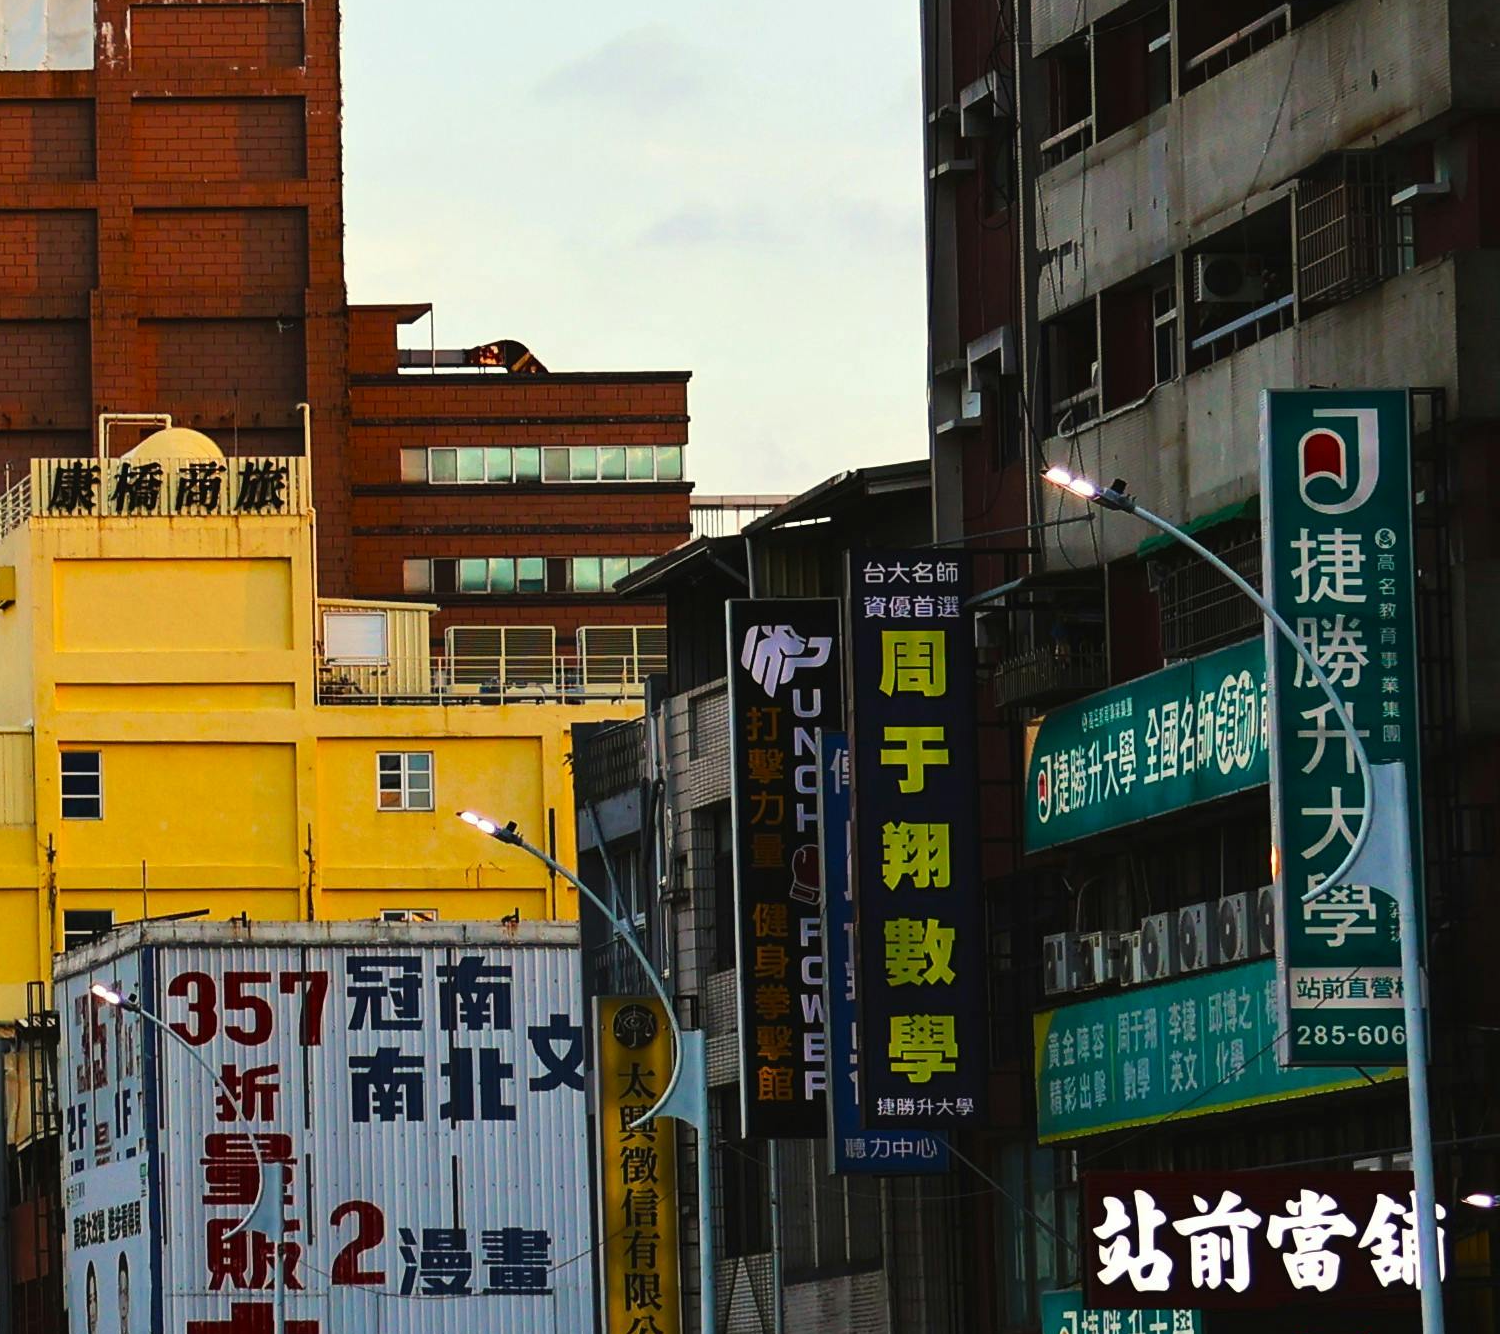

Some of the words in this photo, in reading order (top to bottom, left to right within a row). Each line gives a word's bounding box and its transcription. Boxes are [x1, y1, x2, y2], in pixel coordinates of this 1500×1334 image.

[50, 459, 290, 513] 康橋商旅
[862, 560, 960, 587] 台大名師
[863, 594, 962, 619] 資優首選
[1143, 690, 1216, 786] 全國名師
[1290, 526, 1377, 948] 捷勝升大學
[746, 705, 788, 870] 打擊力量
[1053, 728, 1137, 817] 捷勝升大學
[879, 628, 961, 1086] 周于翔數學
[167, 970, 329, 1048] 357
[347, 955, 513, 1032] 冠南
[753, 902, 794, 1103] 健身拳擊館
[1208, 987, 1252, 1035] 邱博之
[528, 1013, 585, 1092] 文
[1048, 1022, 1105, 1069] 黃金陣容
[1117, 1008, 1158, 1054] 周于翔
[348, 1046, 516, 1124] 南北
[1123, 1058, 1151, 1103] 數學
[1170, 1047, 1198, 1093] 英文
[1216, 1038, 1246, 1085] 化學
[875, 1096, 975, 1120] 捷勝升大學
[1050, 1069, 1107, 1117] 精彩出擊
[844, 1136, 940, 1160] 聽力中心
[400, 1226, 554, 1297] 漫畫
